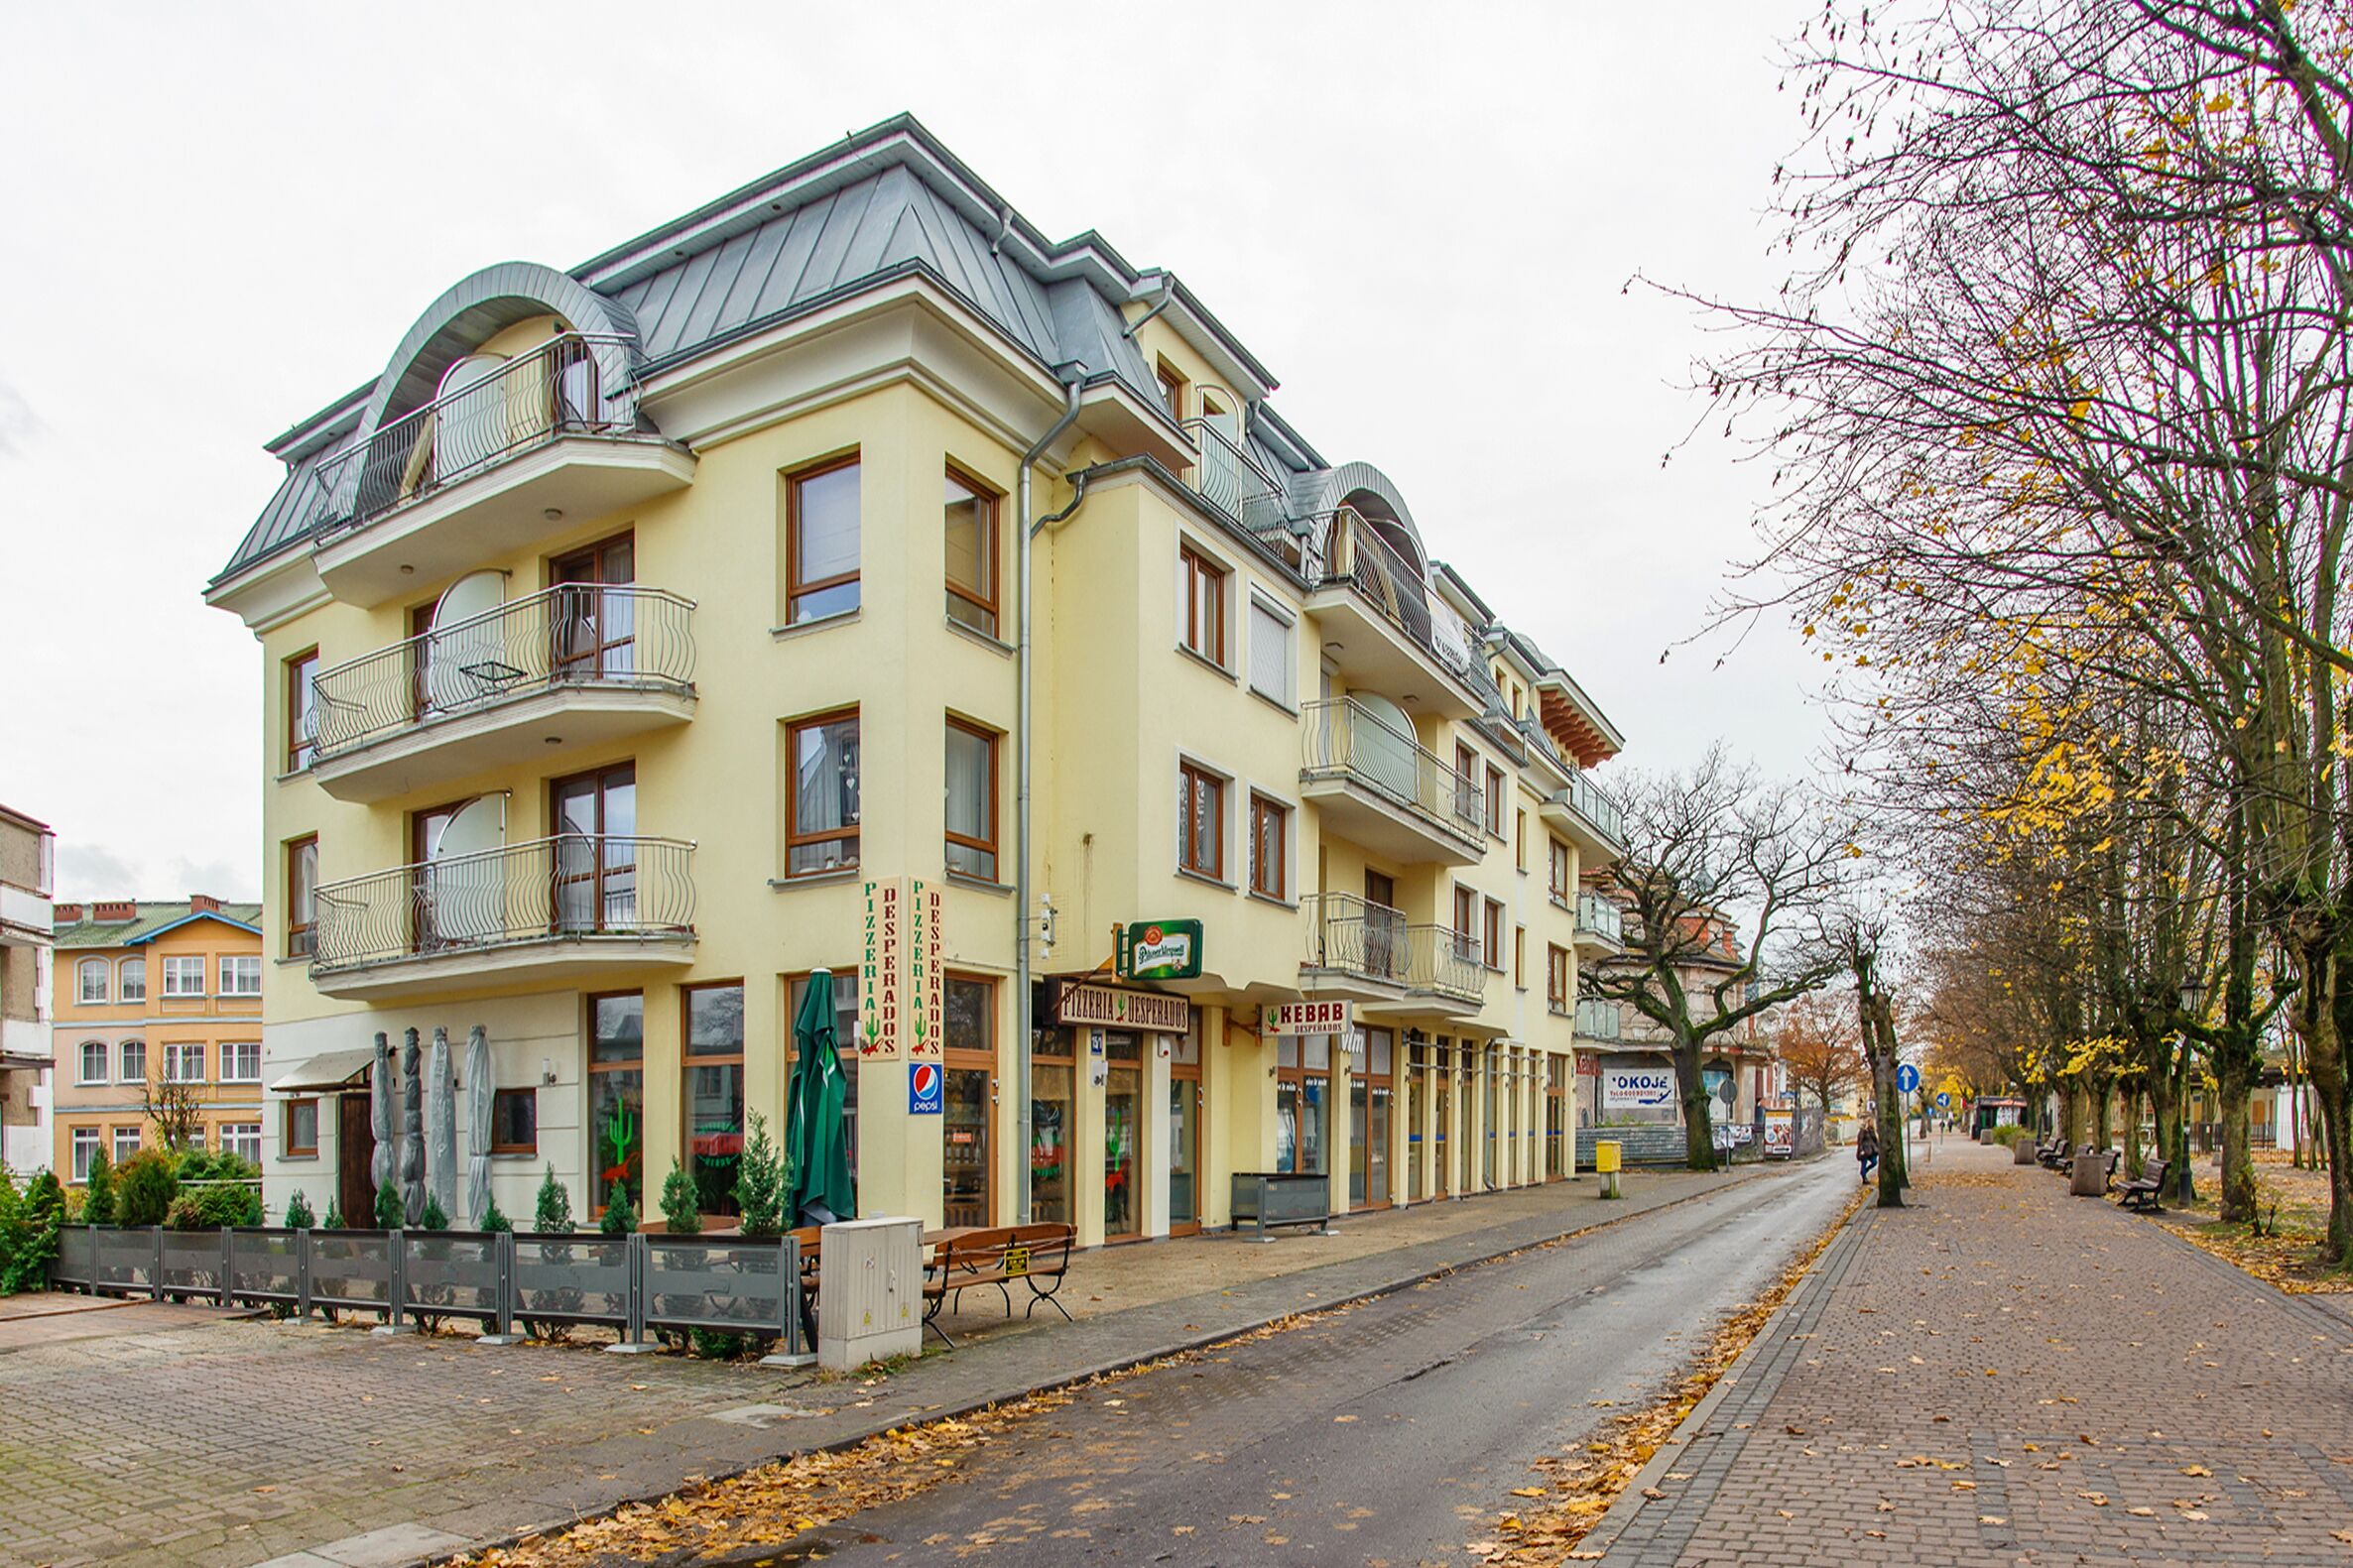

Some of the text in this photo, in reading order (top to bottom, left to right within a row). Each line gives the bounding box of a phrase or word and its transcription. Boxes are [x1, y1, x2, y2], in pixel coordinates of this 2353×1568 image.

[865, 882, 877, 1010] PIZZERIA
[913, 881, 924, 1010] PIZZERIA
[883, 888, 897, 1053] DESPERADOS
[929, 892, 940, 1054] DESPERADOS
[1063, 987, 1186, 1028] PIZZERIA DESPERADOS
[1281, 1003, 1343, 1024] KEBAB
[1295, 1023, 1342, 1033] DESPERADOS
[1612, 1075, 1668, 1089] OKOJE
[914, 1100, 937, 1113] pepsi
